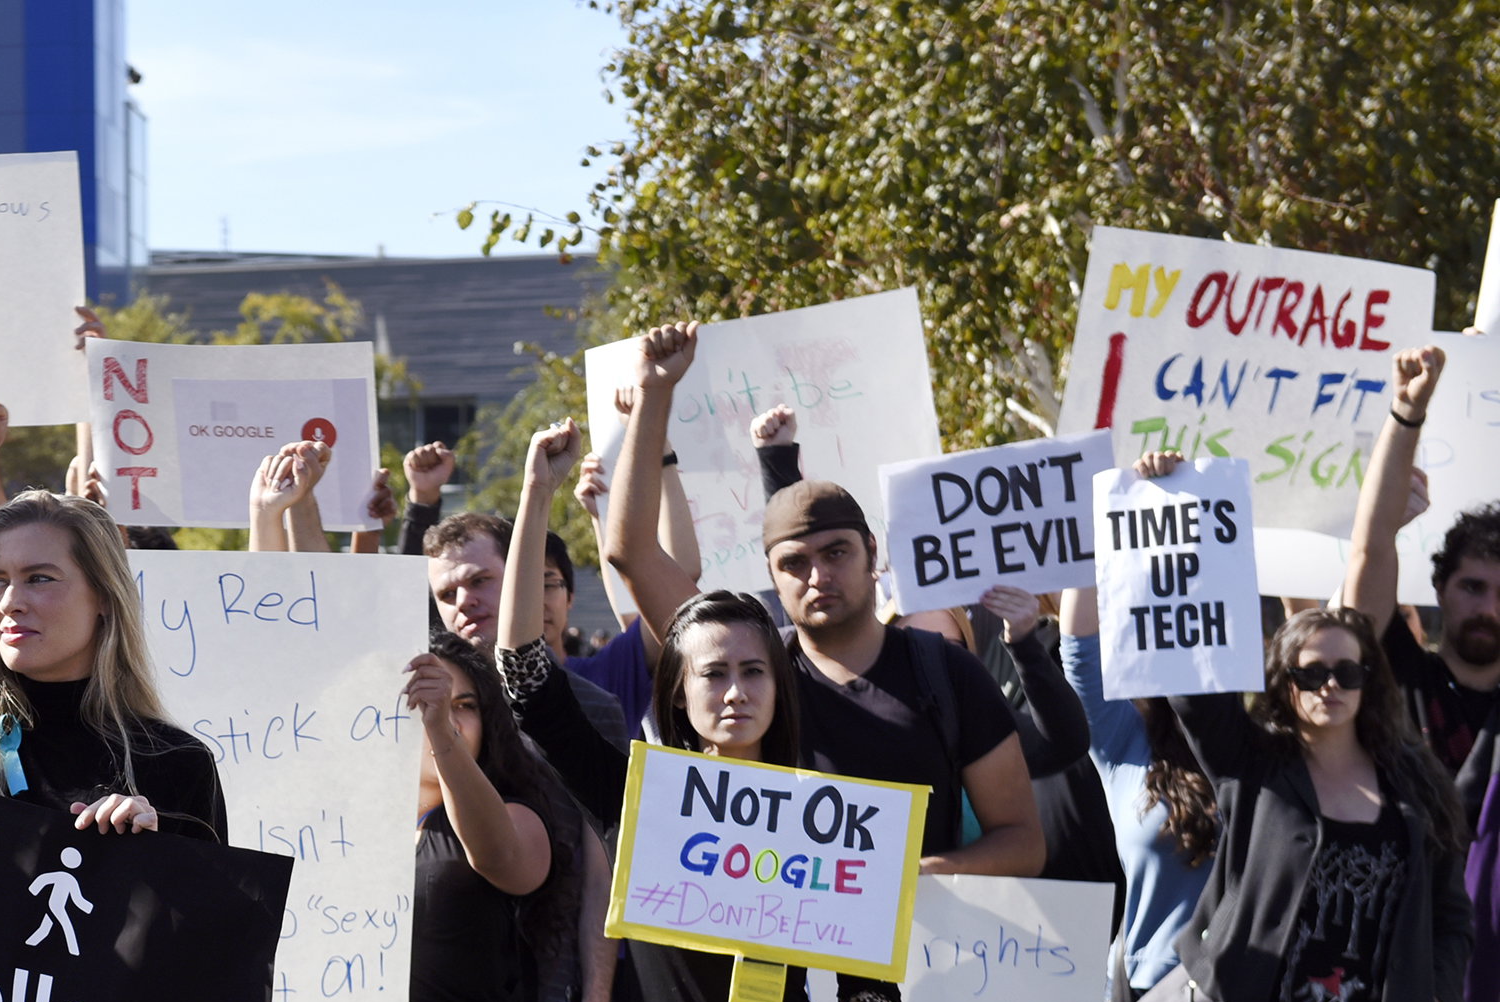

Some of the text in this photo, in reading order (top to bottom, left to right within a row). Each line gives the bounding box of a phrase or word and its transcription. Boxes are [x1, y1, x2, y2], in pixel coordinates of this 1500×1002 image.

[1103, 262, 1392, 352] MY OUTRAGE
[791, 367, 864, 410] be
[1154, 352, 1299, 415] CAN'T
[102, 356, 159, 511] NOT
[188, 424, 276, 439] OK GOOGLE
[931, 452, 1083, 524] DON'T
[912, 516, 1095, 587] BE EVIL
[1106, 499, 1237, 551] TIME'S
[218, 571, 321, 631] Red
[1150, 553, 1200, 598] UP
[1129, 601, 1228, 651] TECH
[680, 765, 880, 852] NOT OK
[679, 831, 867, 895] GOOGLE
[923, 924, 1076, 996] rights
